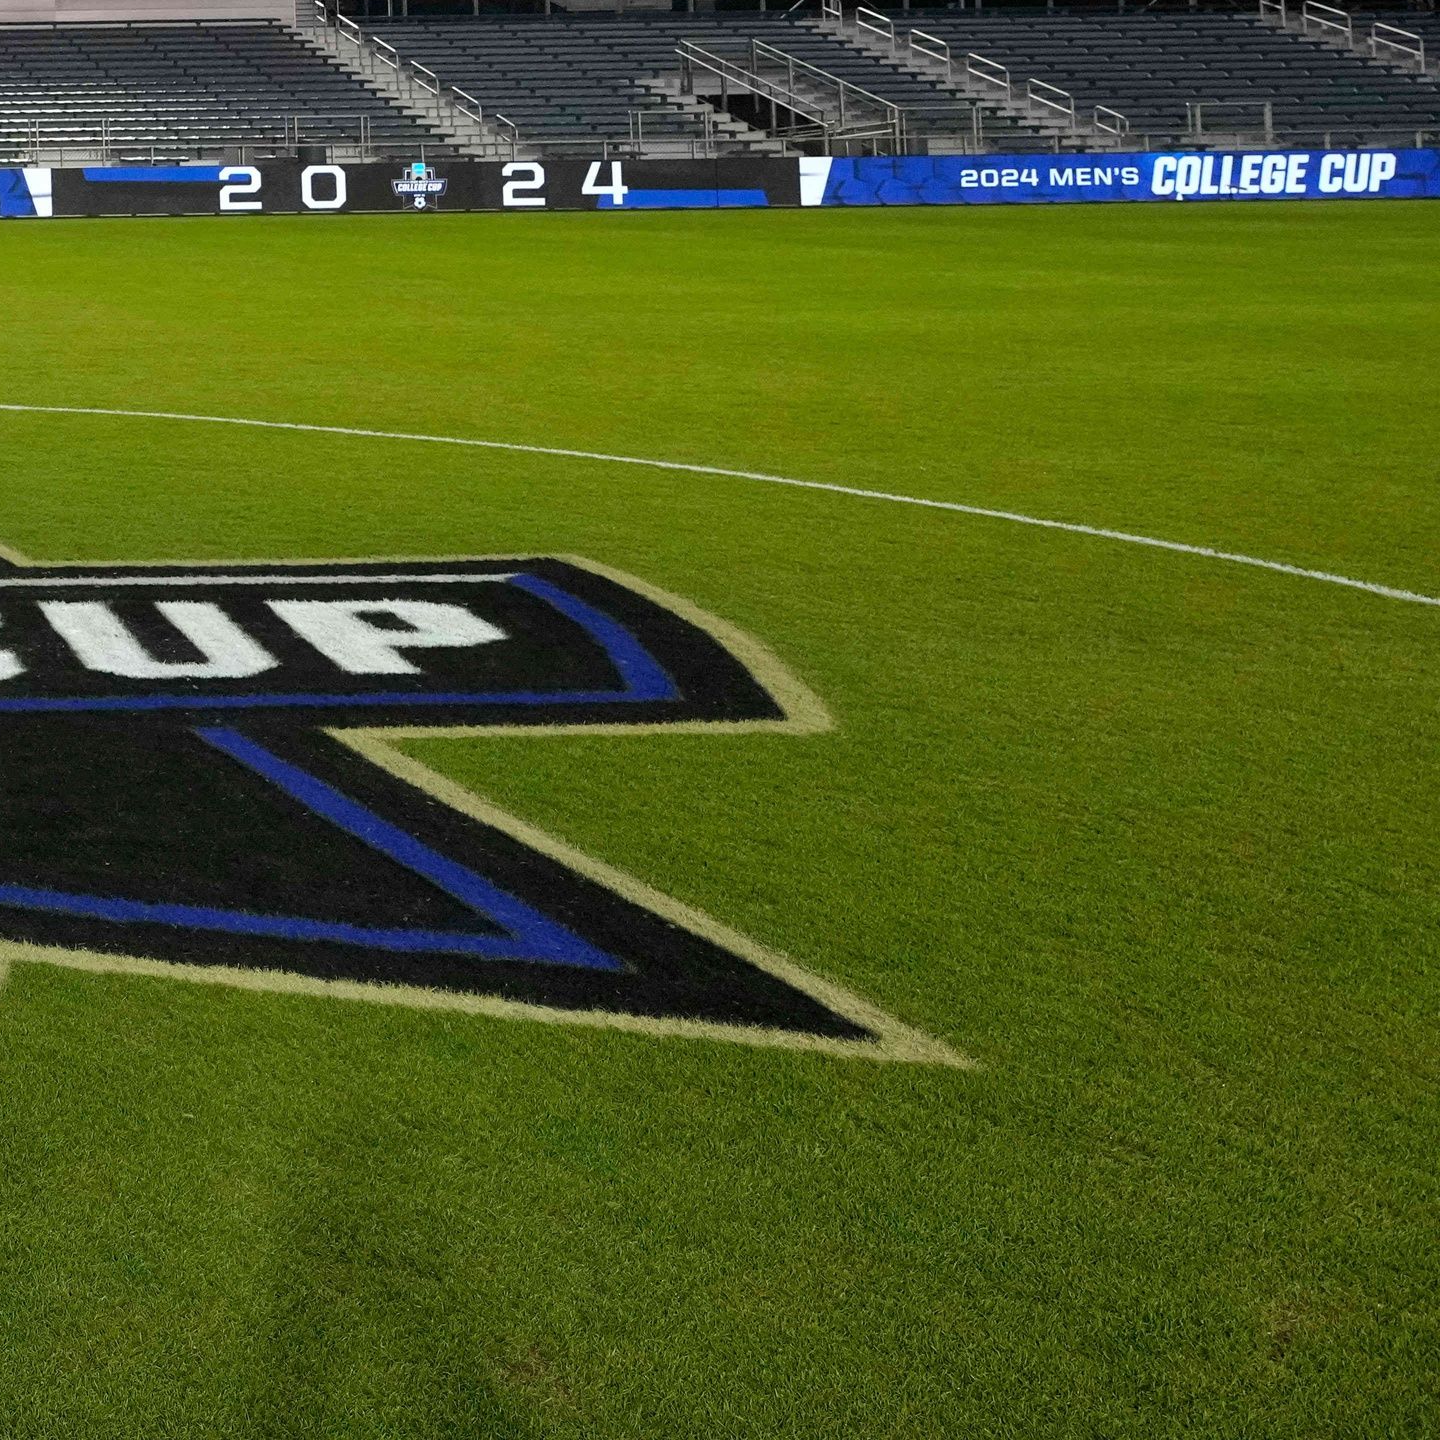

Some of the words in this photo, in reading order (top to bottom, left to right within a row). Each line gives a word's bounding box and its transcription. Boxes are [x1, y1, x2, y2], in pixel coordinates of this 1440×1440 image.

[960, 169, 1039, 188] 2024
[1152, 155, 1310, 196] COLLEGE
[1319, 153, 1397, 193] CUP
